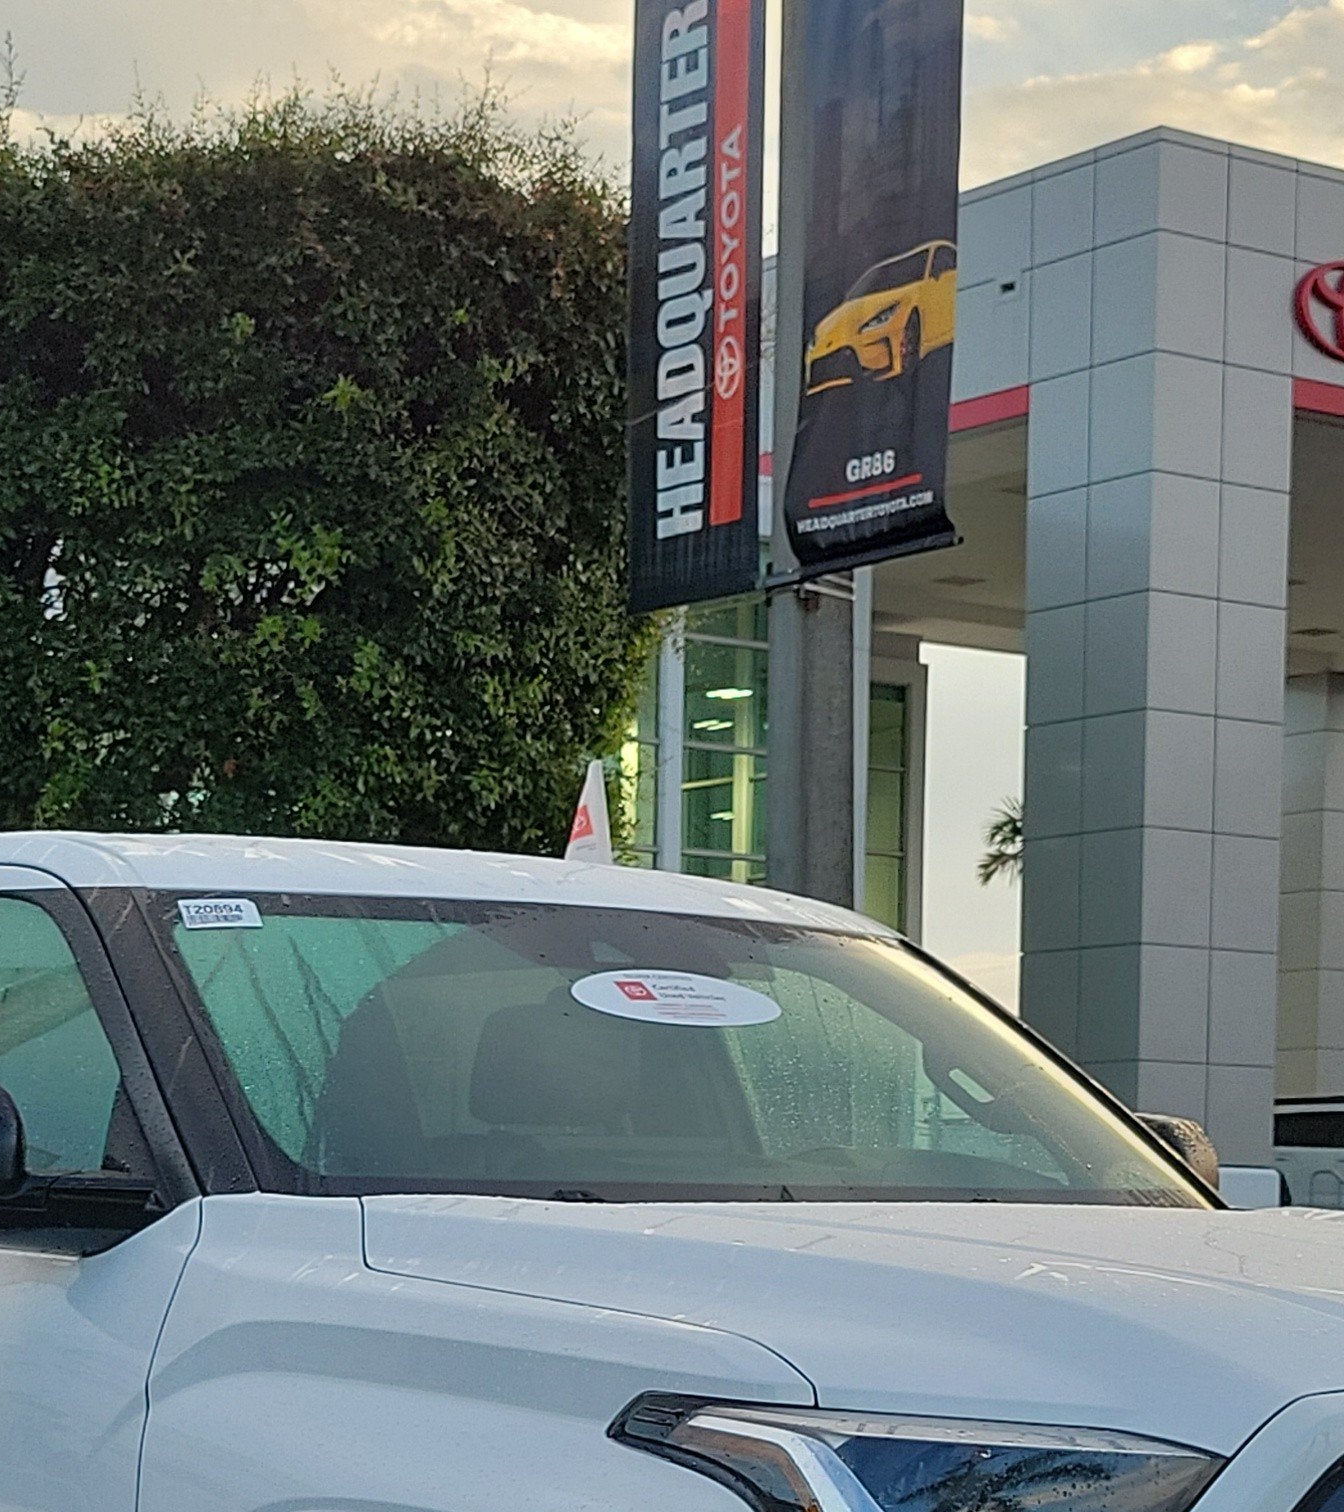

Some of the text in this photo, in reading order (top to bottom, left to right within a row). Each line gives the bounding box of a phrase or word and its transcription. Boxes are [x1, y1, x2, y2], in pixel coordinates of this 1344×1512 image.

[657, 0, 714, 541] HEADQUARTER
[716, 122, 743, 329] TOYOTA
[845, 449, 896, 483] GR86
